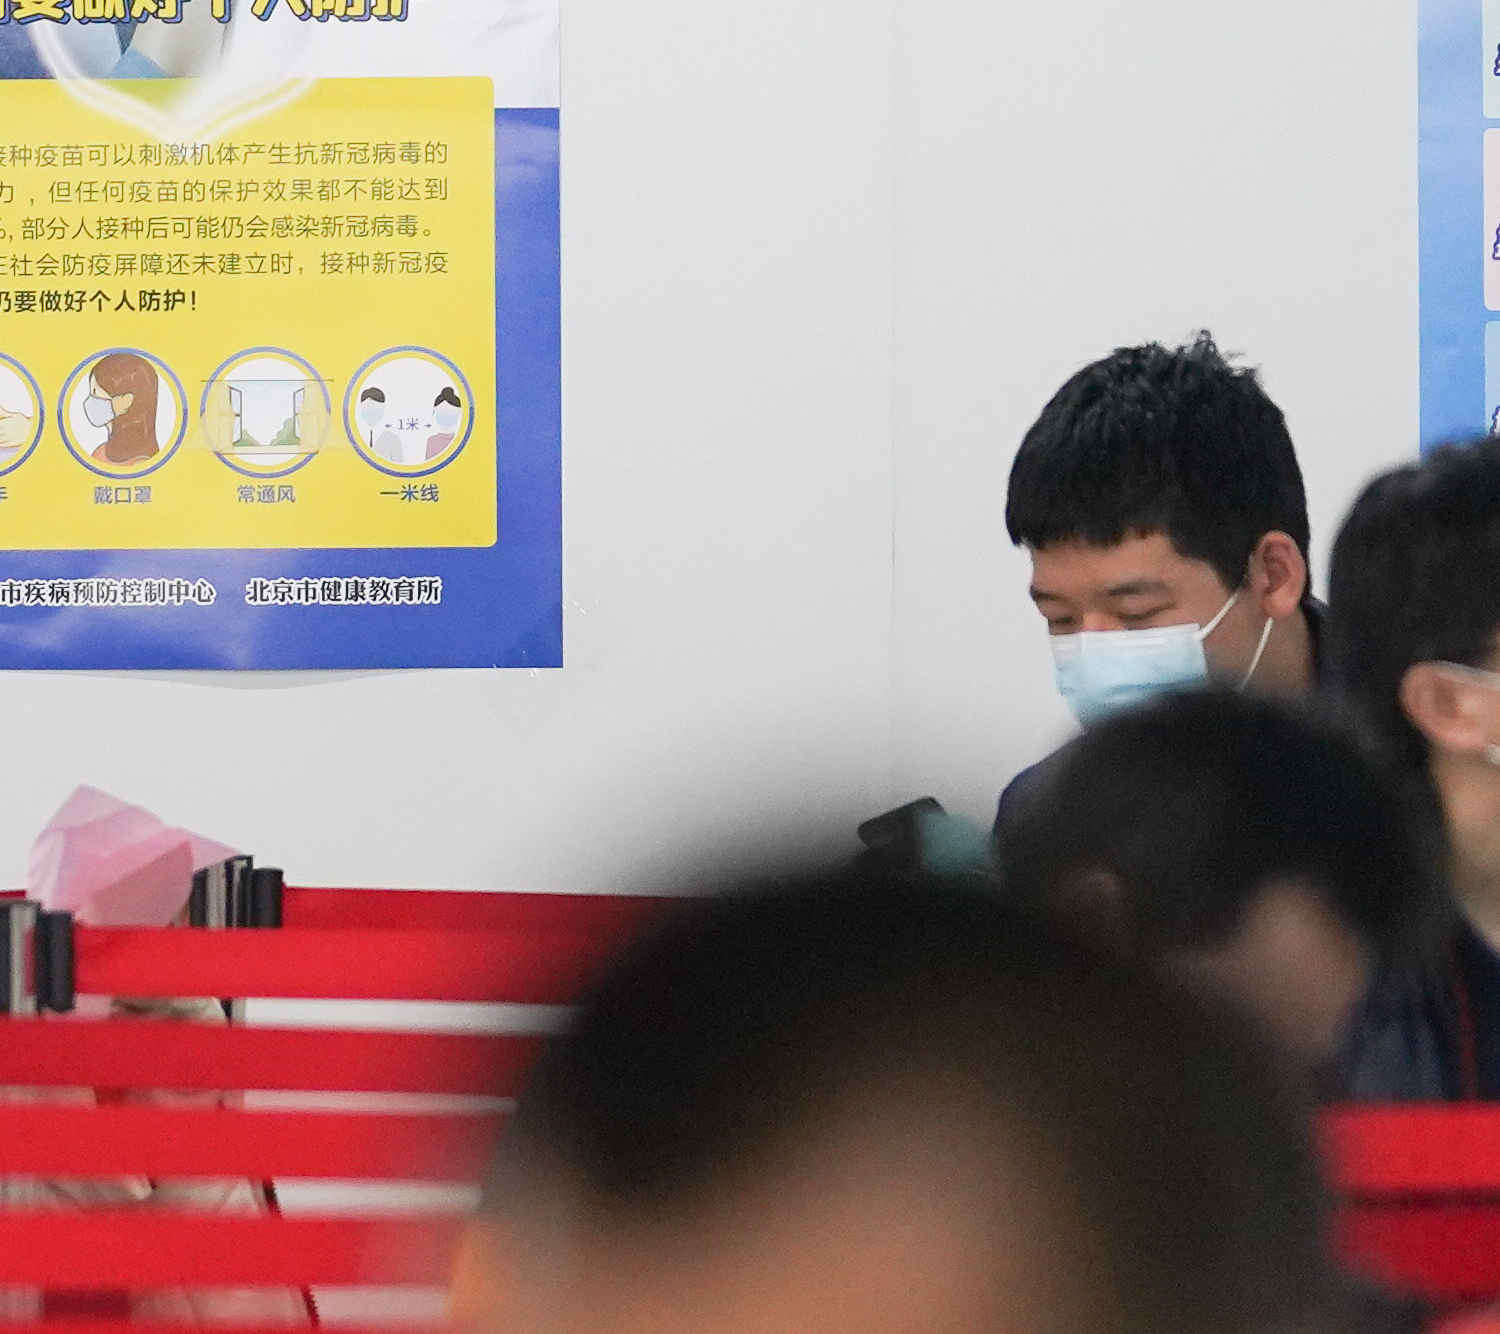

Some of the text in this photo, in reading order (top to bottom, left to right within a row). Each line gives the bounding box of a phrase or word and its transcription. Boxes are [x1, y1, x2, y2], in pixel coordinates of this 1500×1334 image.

[94, 485, 153, 505] 戴口罩
[237, 484, 296, 505] 常通风
[380, 483, 439, 504] 一米线
[246, 577, 442, 606] 北京市健康教育所
